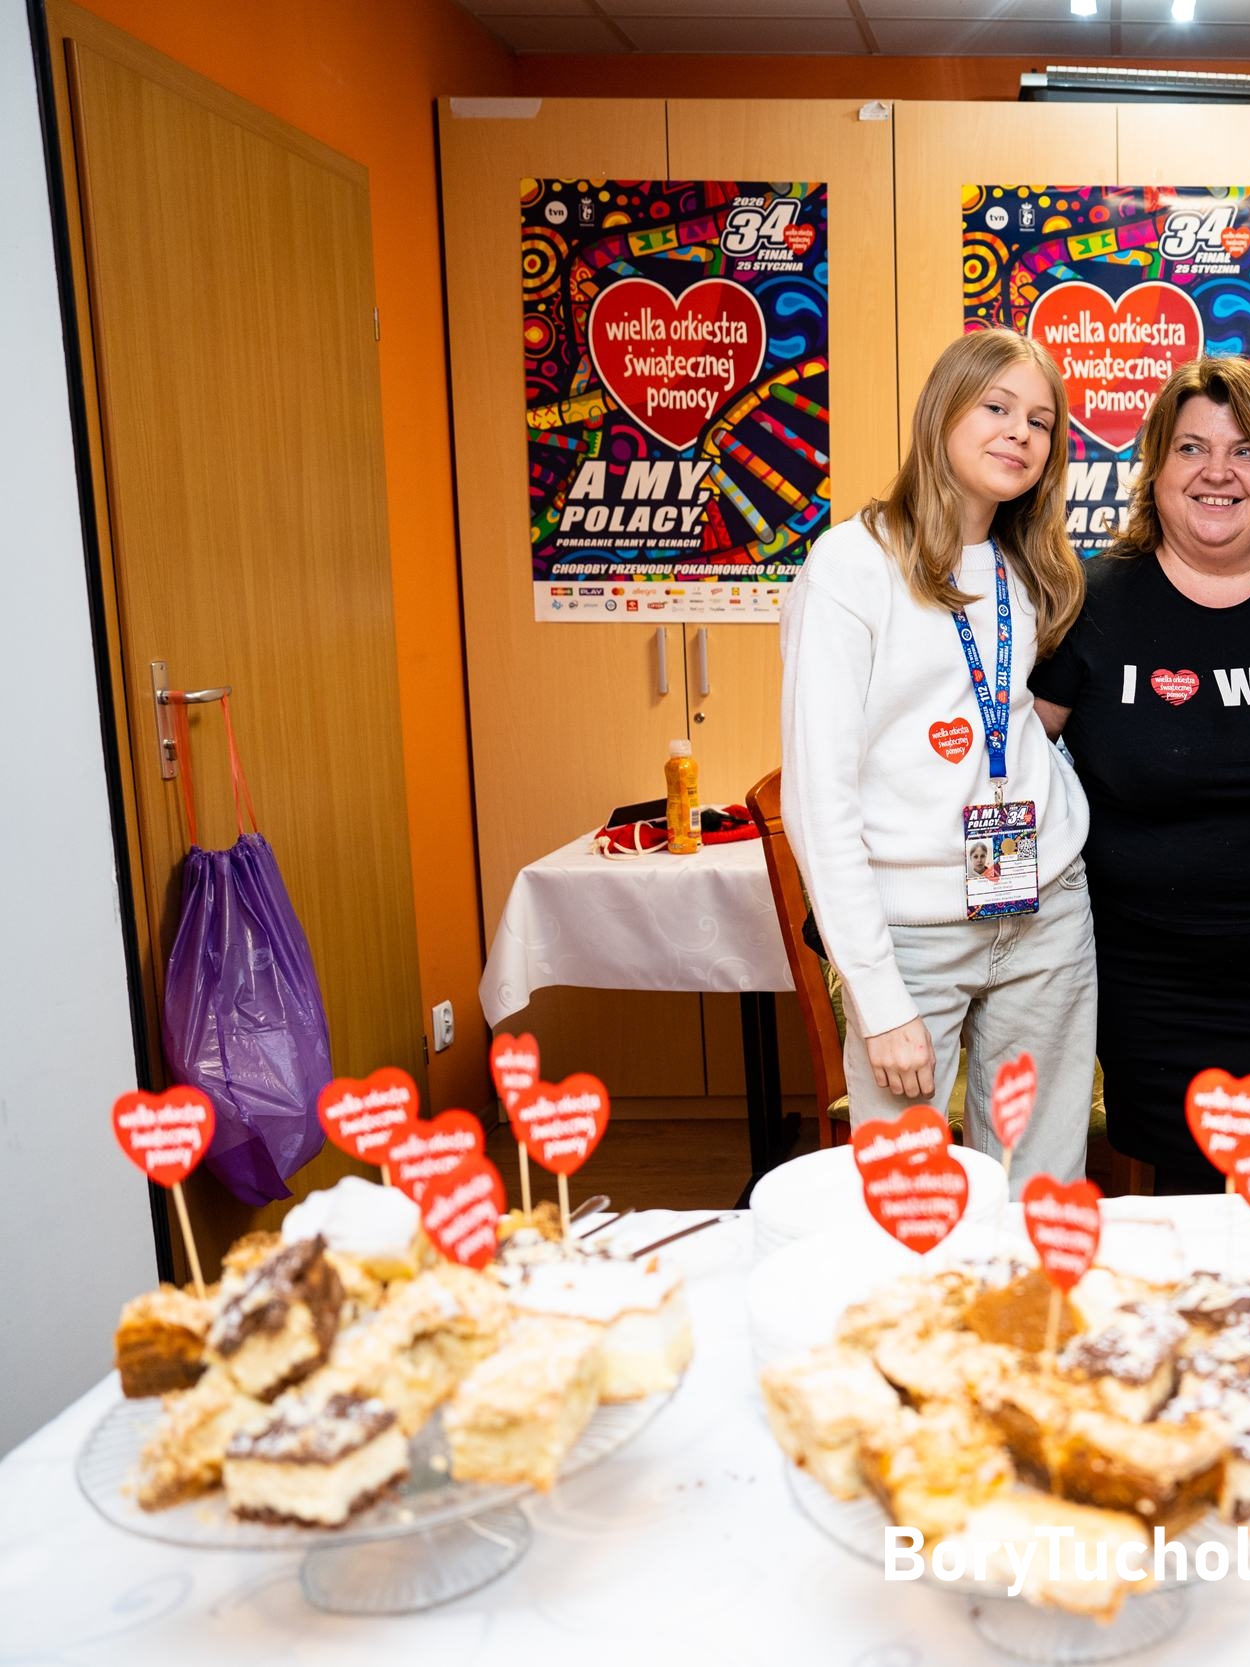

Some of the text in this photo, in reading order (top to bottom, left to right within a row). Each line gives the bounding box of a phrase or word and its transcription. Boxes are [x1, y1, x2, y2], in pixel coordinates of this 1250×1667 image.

[733, 197, 764, 206] 2026
[722, 199, 800, 256] 34
[1160, 204, 1237, 259] 34
[736, 262, 803, 271] 25 STYCZNIA
[1175, 265, 1240, 274] 25 STYCZNIA
[605, 307, 748, 344] wielka orkiestra
[1045, 310, 1185, 346] wielka orkiestra
[624, 345, 734, 391] świątecznej
[647, 386, 718, 420] pomocy
[1085, 388, 1157, 420] pomocy
[569, 461, 711, 505] A MY,
[560, 506, 703, 535] POLACY,
[556, 538, 701, 548] POMAGANIE MAMY W GENACH!
[552, 563, 608, 574] CHOROBY
[609, 564, 673, 575] PRZEWODU
[674, 565, 764, 575] POKARMOWEGO
[766, 565, 776, 575] U
[978, 685, 990, 702] 112
[998, 671, 1008, 686] 112
[1121, 665, 1137, 704] I
[1006, 807, 1028, 826] 34
